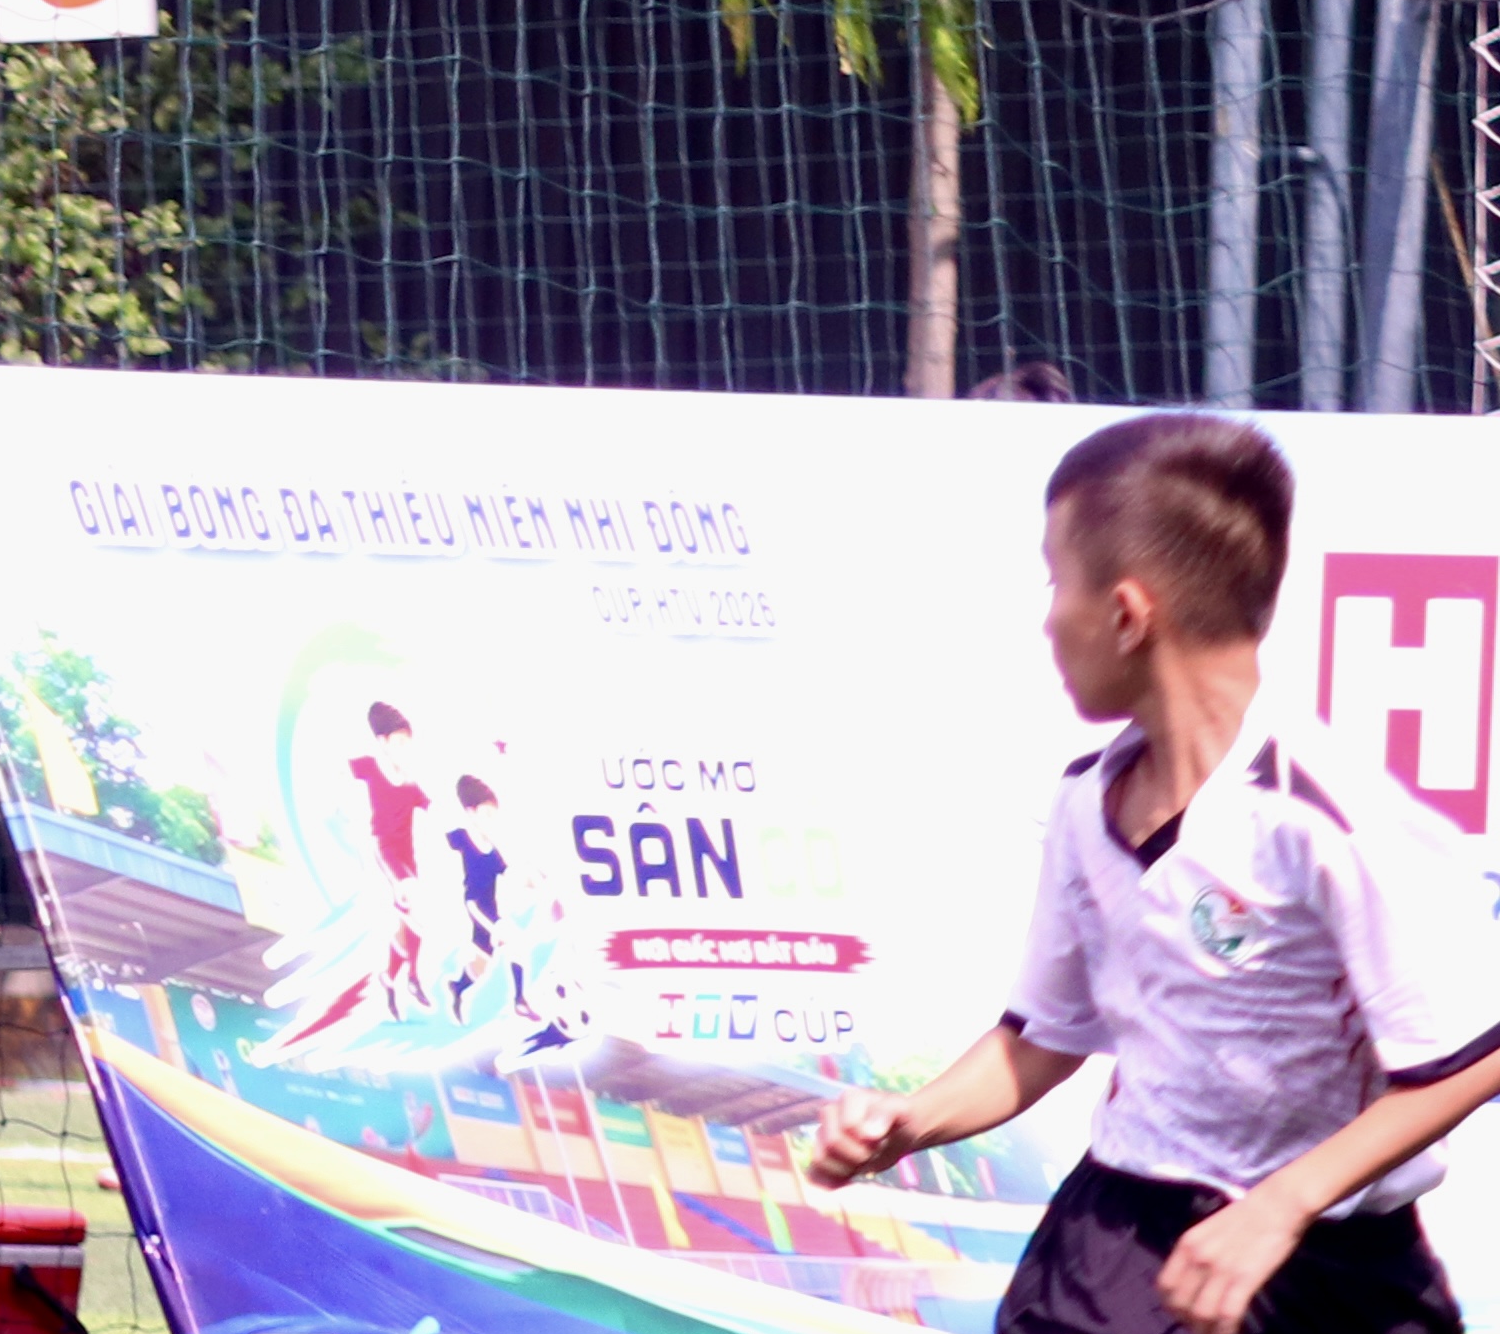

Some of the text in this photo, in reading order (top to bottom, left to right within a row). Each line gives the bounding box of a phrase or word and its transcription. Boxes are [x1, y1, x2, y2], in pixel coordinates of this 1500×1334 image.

[562, 497, 636, 553] NHI
[652, 587, 702, 627] HTV
[709, 590, 778, 628] 2026
[570, 800, 745, 900] SÂN
